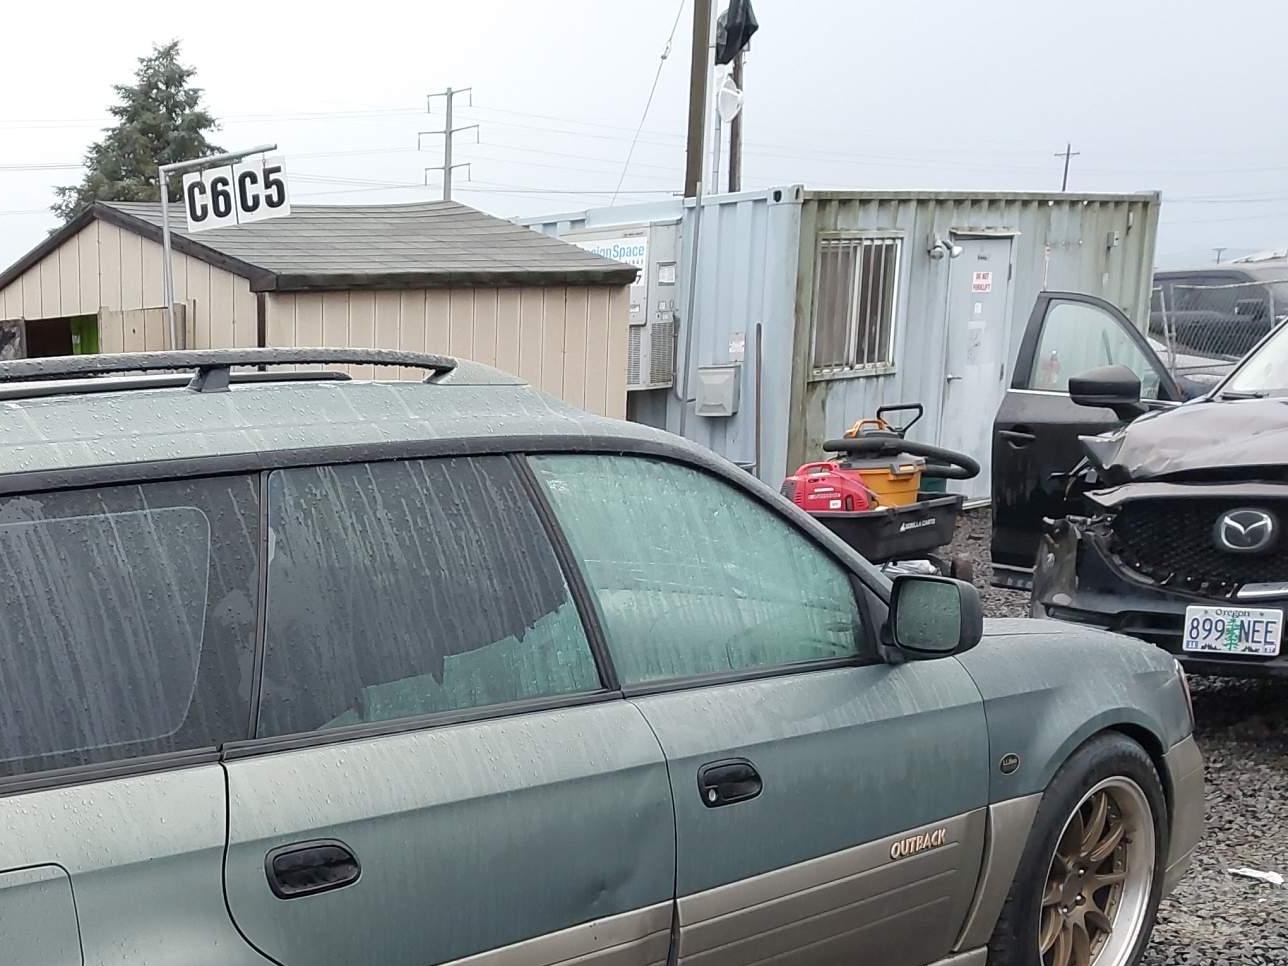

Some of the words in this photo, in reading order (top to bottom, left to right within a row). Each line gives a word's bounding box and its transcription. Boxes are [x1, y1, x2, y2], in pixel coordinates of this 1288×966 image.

[187, 176, 232, 222] C6
[238, 165, 286, 213] C5
[1215, 608, 1250, 618] Oregon
[1189, 617, 1226, 641] 899
[1237, 619, 1277, 645] NEE
[890, 828, 946, 859] OUTBACK
